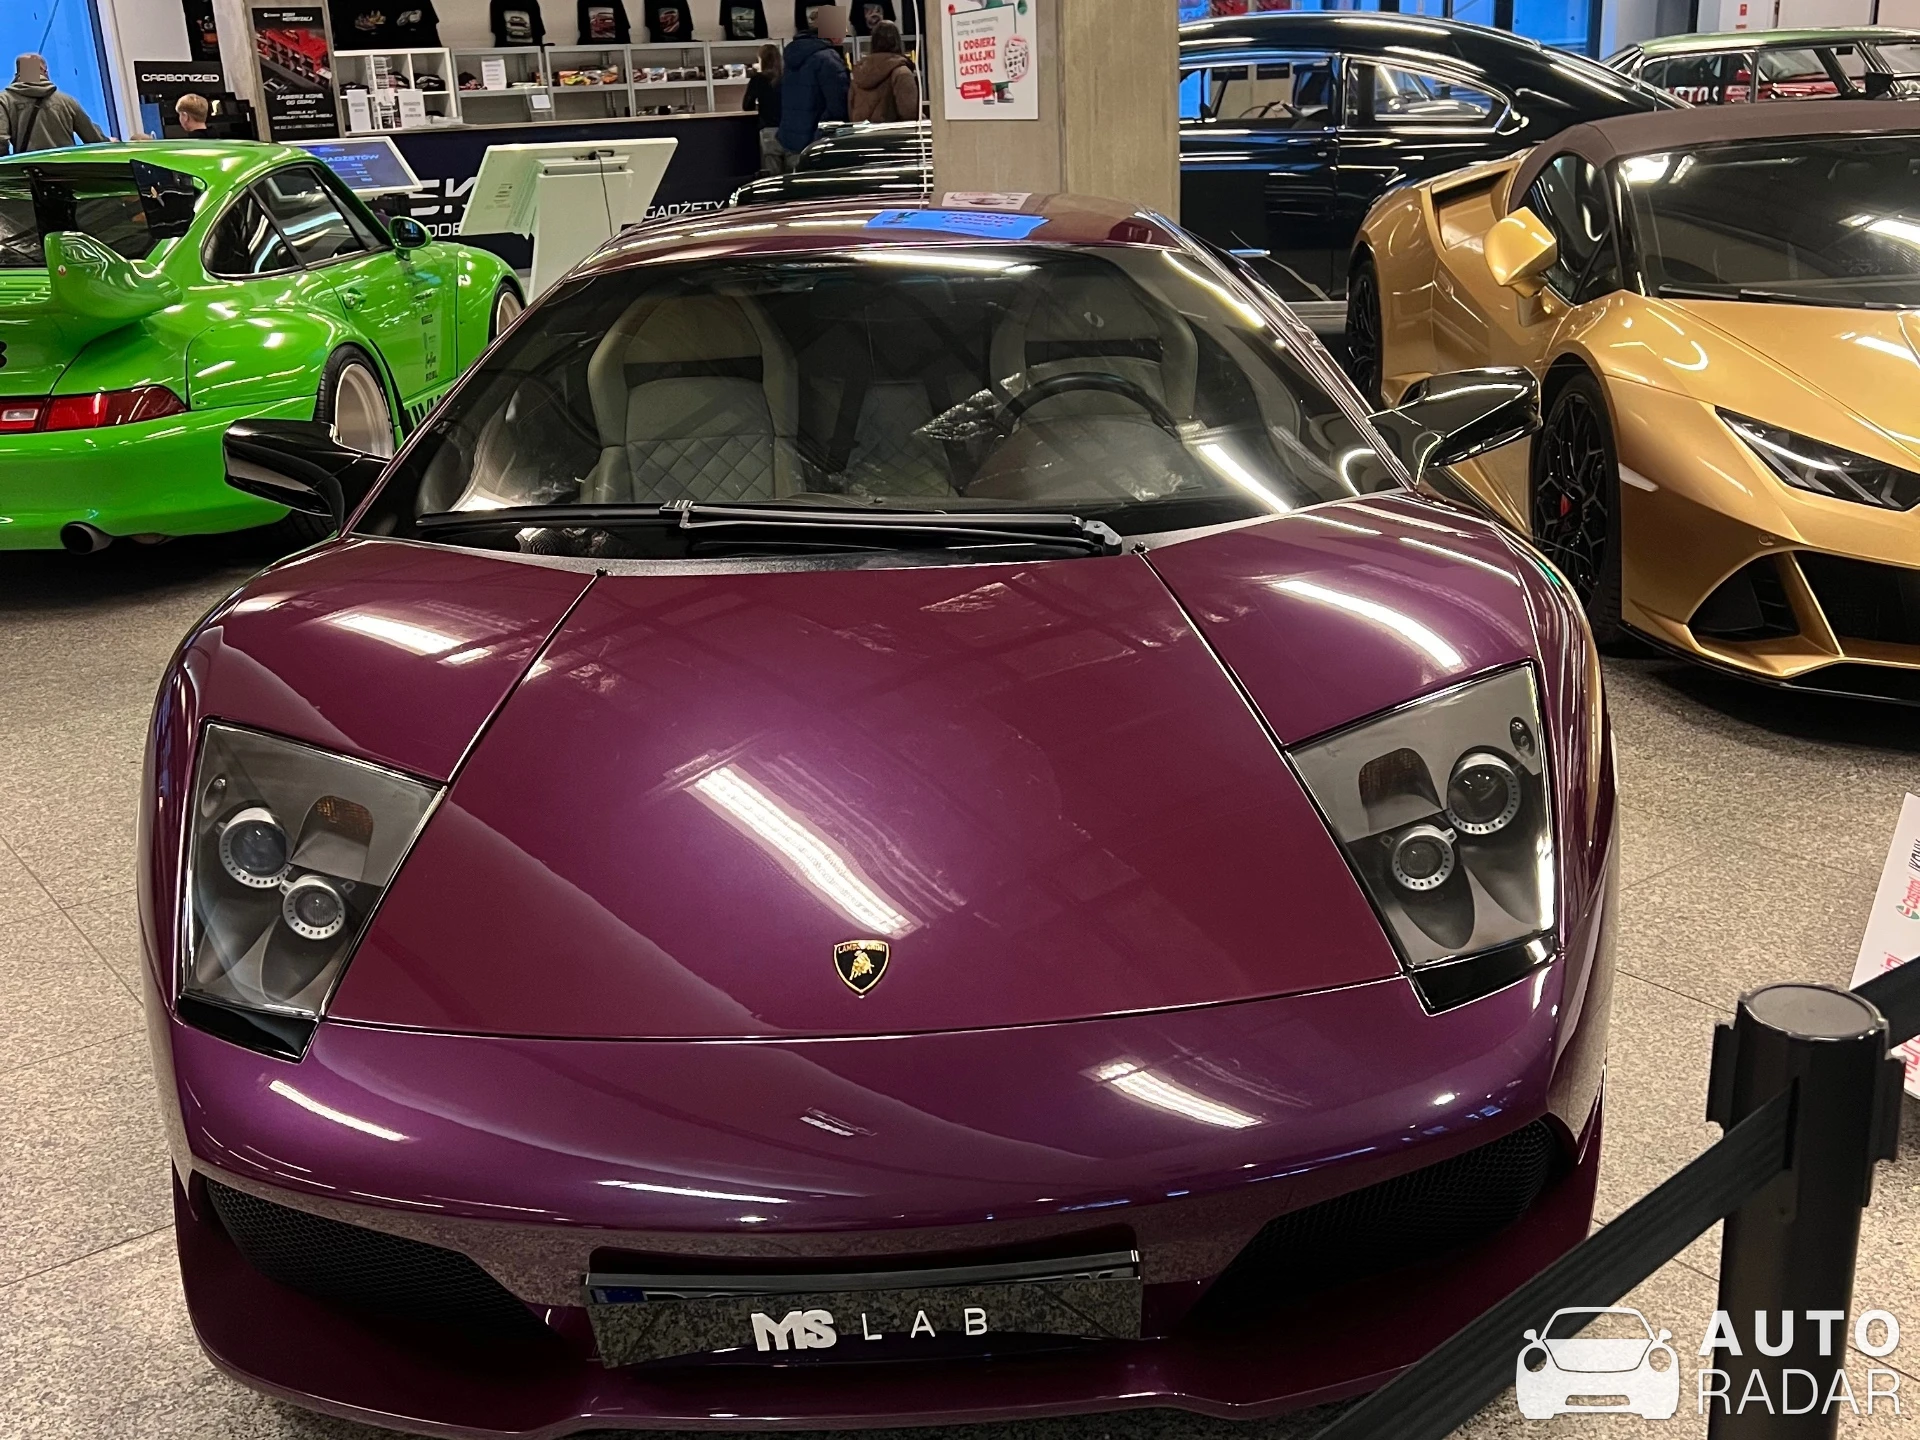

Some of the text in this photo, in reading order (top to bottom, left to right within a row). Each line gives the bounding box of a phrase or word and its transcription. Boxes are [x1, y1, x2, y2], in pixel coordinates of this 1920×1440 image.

[963, 36, 996, 50] ODBIERZ
[959, 50, 996, 64] NAKLEJKI
[960, 63, 993, 76] CASTROL
[141, 73, 220, 83] CARBONIZED
[750, 1309, 837, 1351] MS
